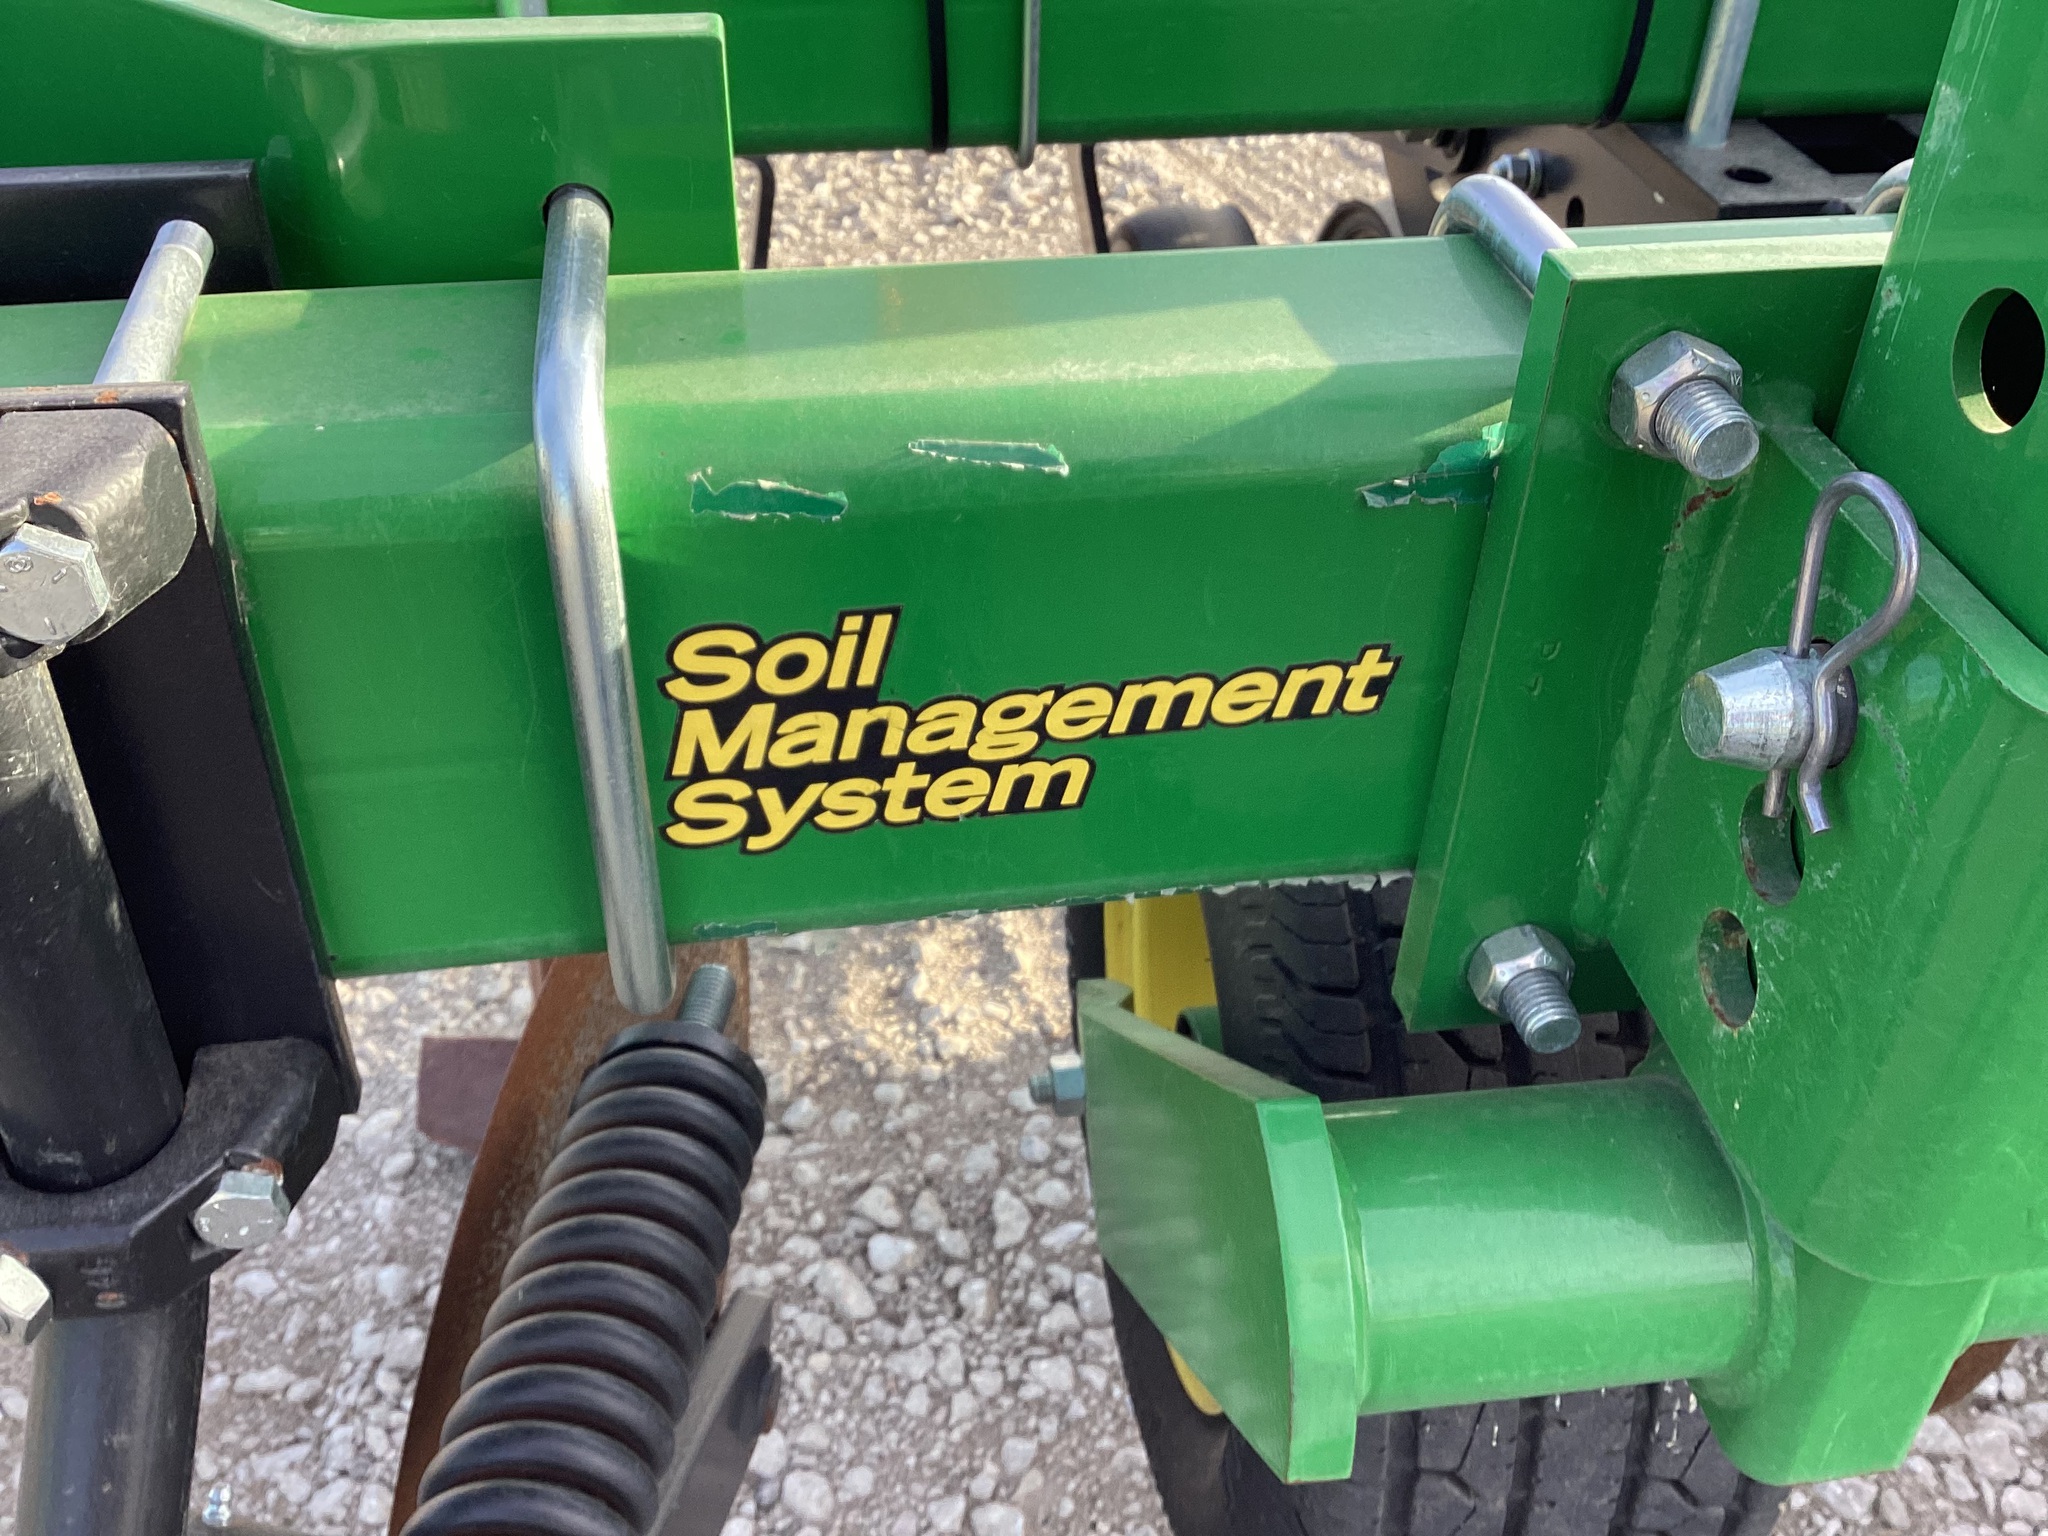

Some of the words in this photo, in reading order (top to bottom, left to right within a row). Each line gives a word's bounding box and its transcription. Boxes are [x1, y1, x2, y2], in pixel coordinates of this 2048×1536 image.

[665, 613, 893, 703] Soil
[670, 647, 1394, 776] Management
[665, 756, 1091, 852] System
